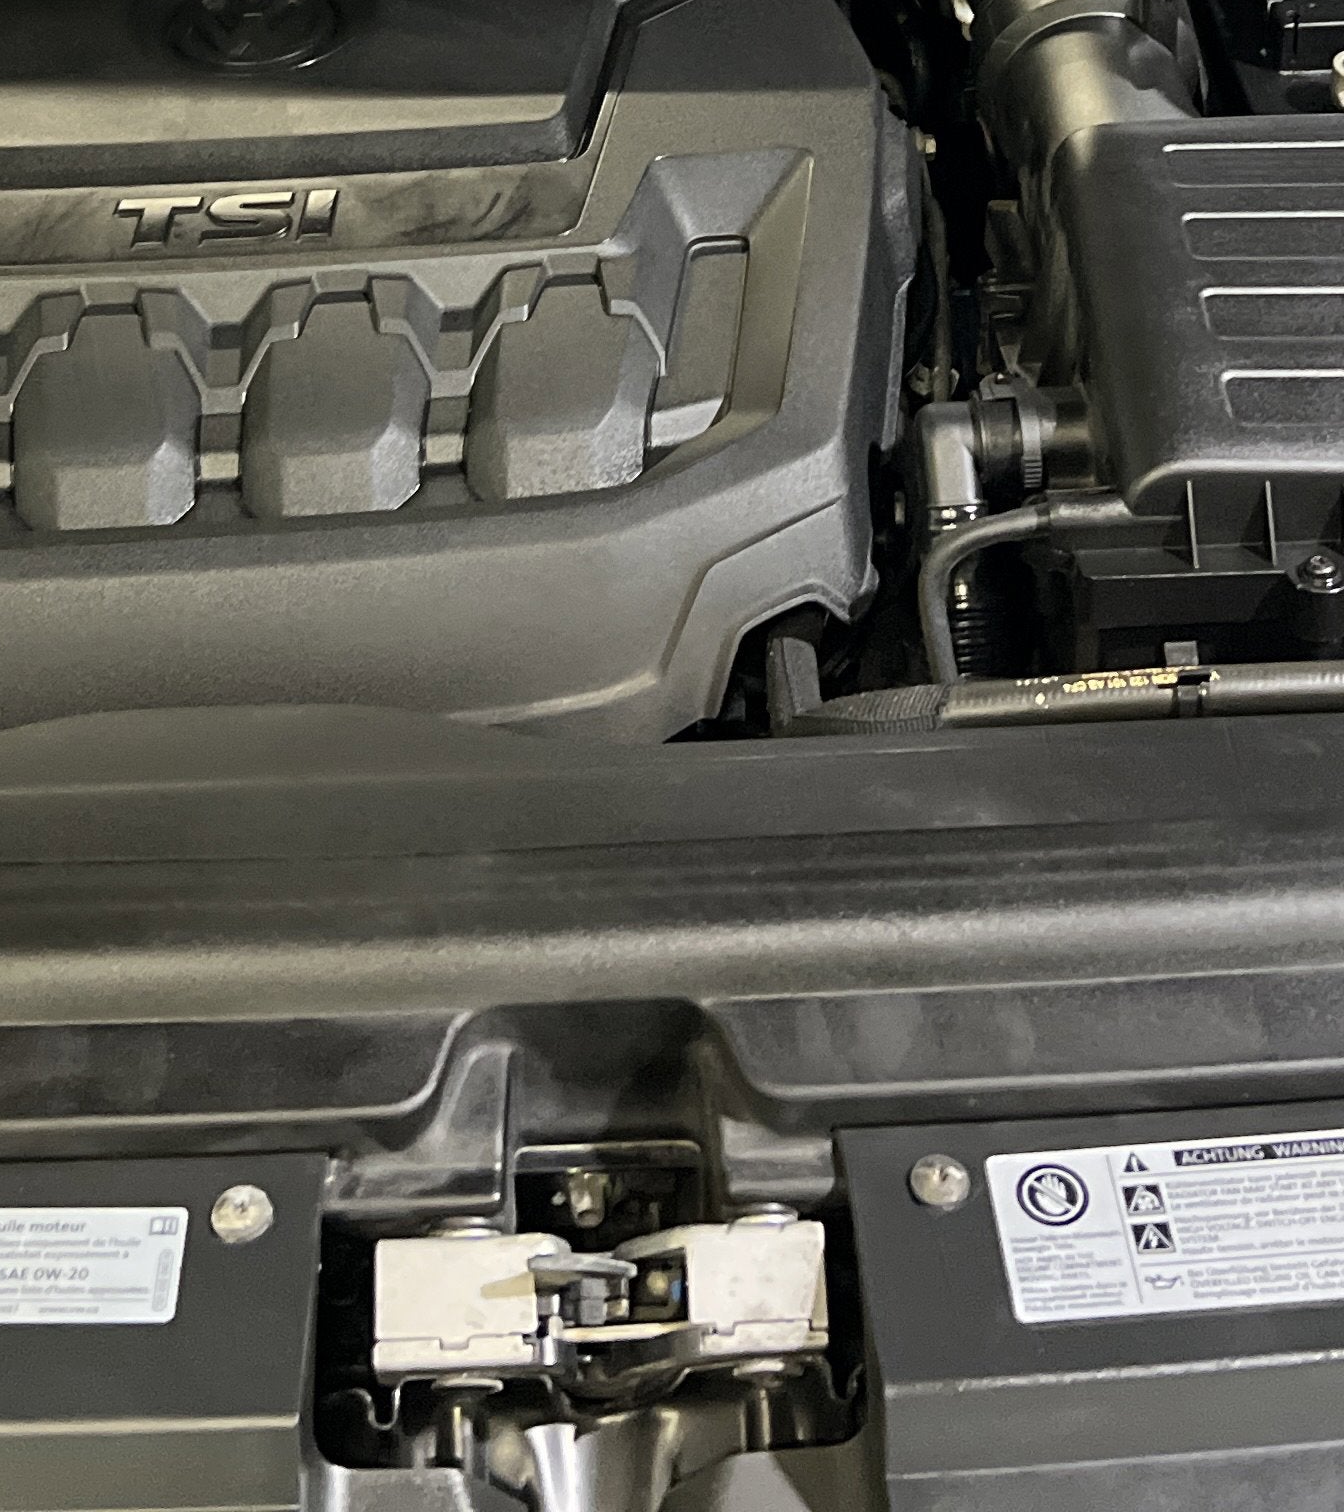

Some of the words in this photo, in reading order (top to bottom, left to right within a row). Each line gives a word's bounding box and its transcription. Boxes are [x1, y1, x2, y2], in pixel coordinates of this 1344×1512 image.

[114, 188, 339, 249] TSI
[1179, 1144, 1265, 1165] ACHTUNG
[28, 1221, 86, 1233] moteur
